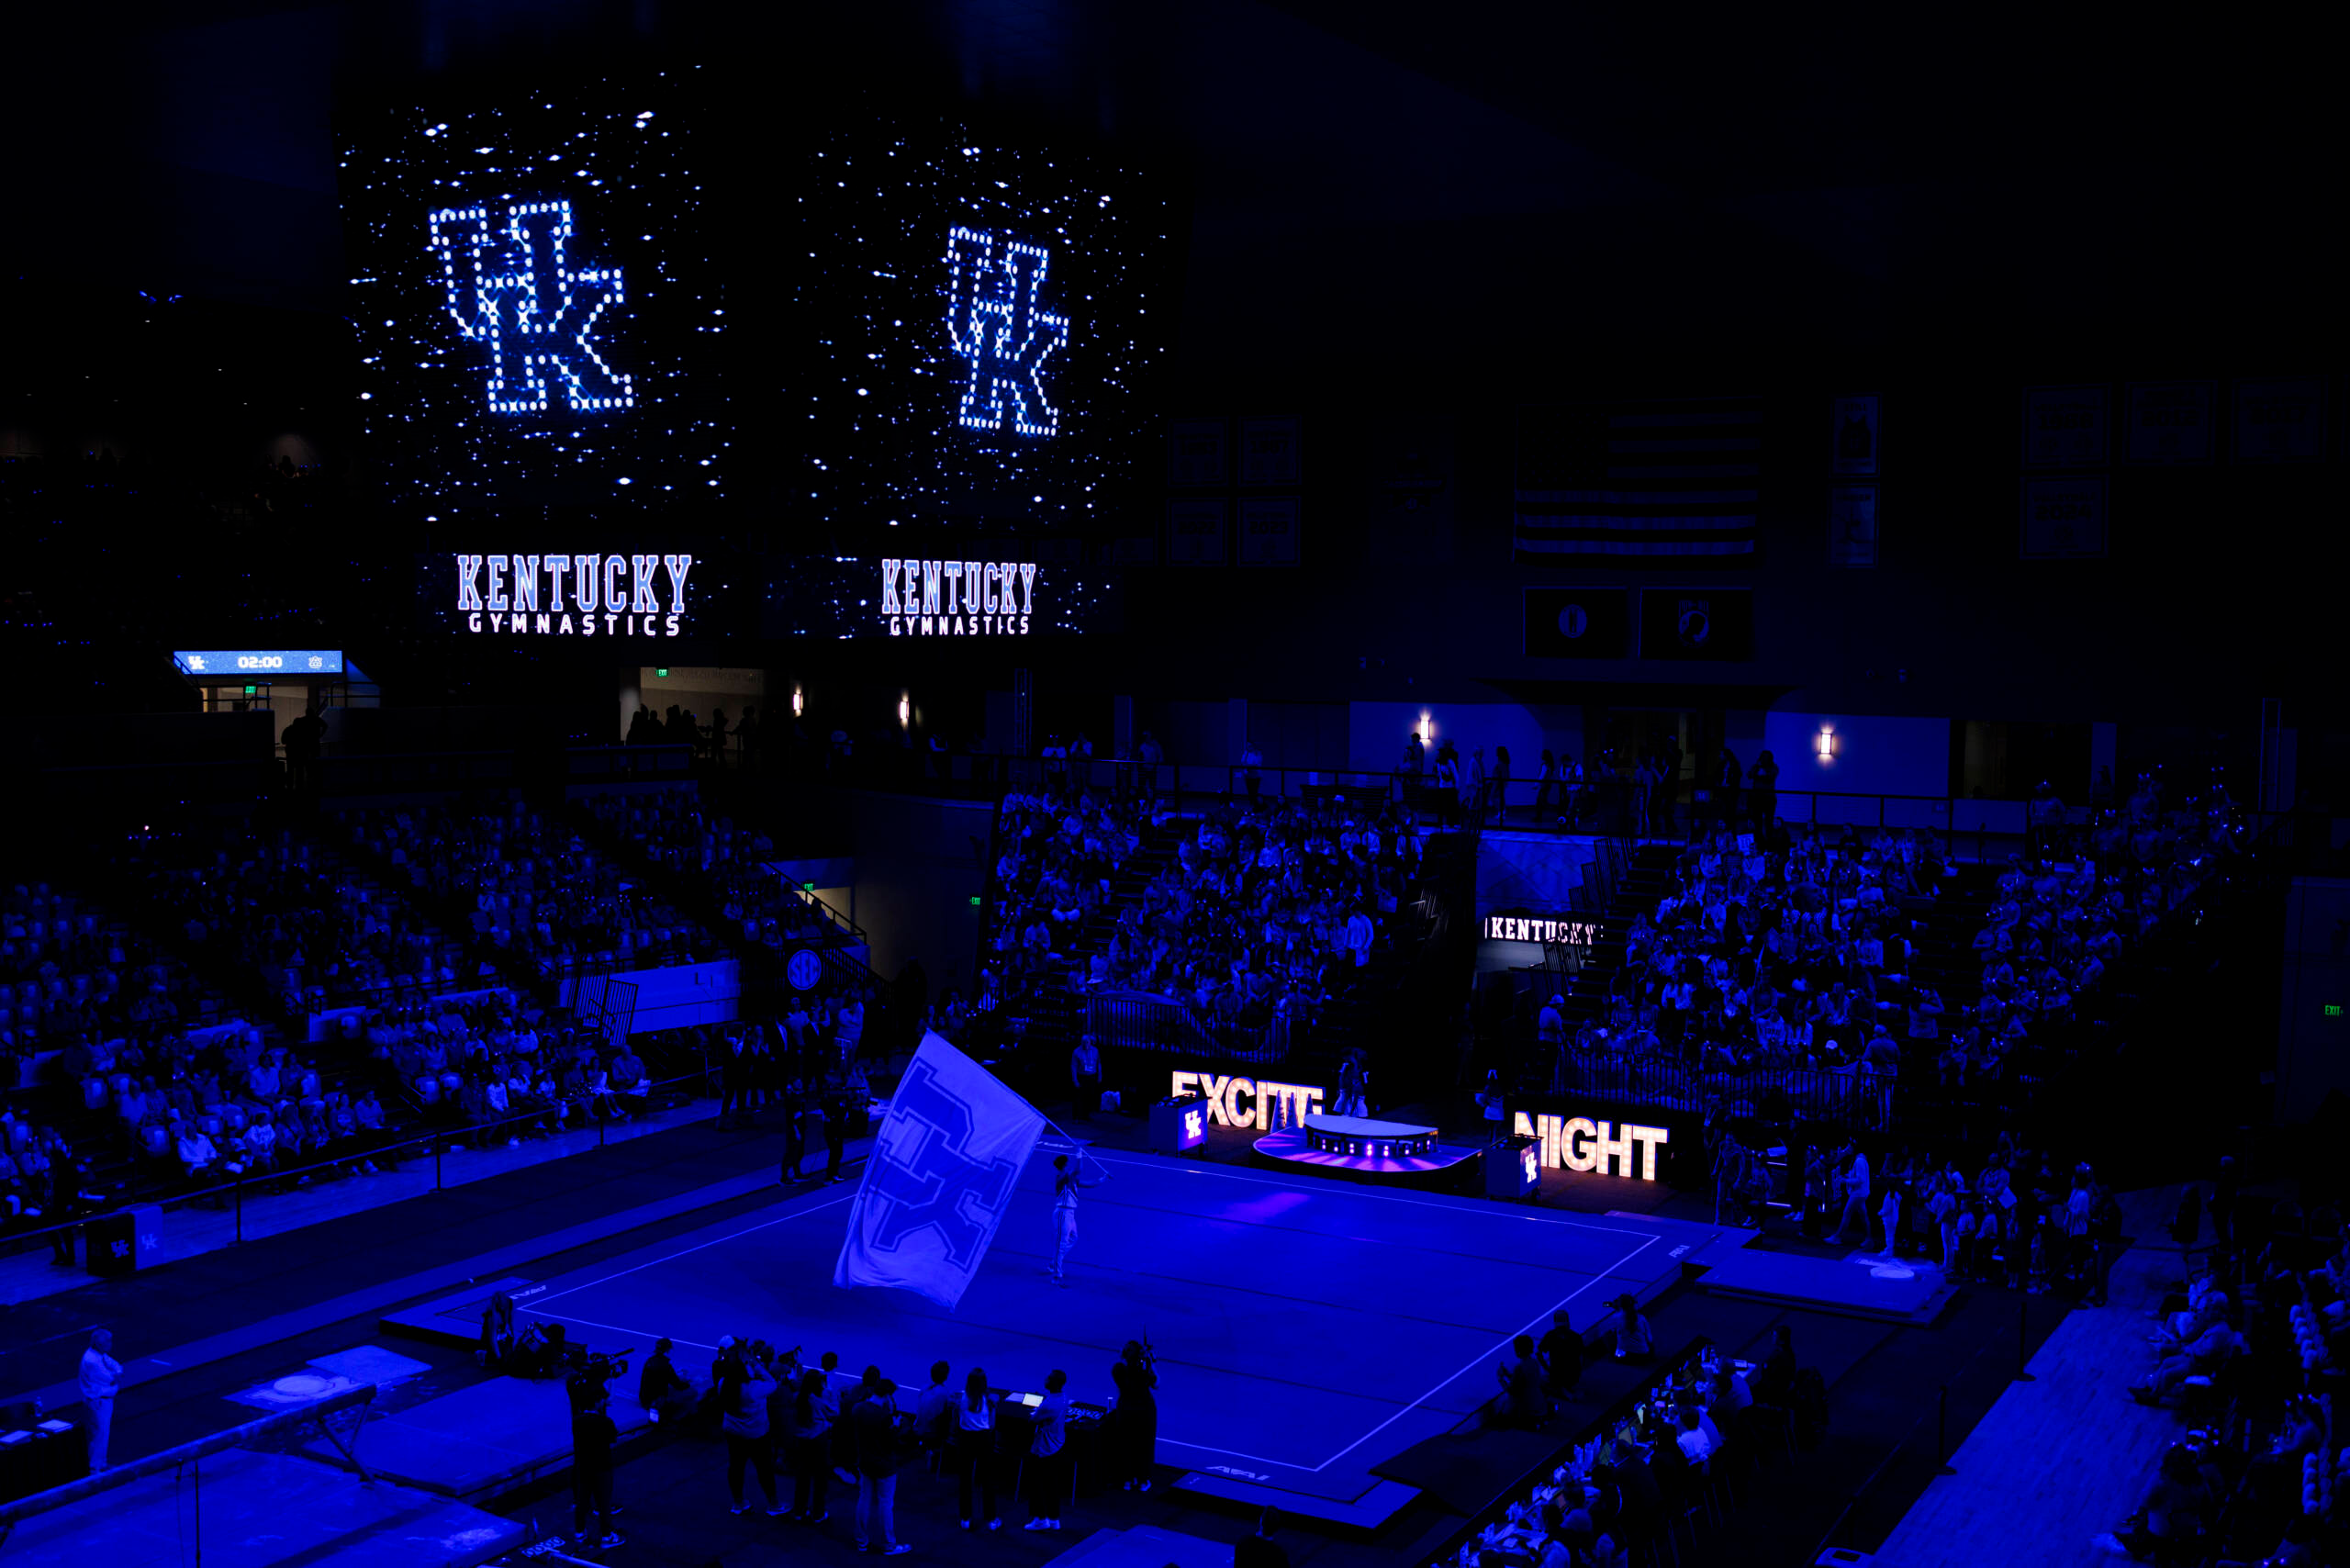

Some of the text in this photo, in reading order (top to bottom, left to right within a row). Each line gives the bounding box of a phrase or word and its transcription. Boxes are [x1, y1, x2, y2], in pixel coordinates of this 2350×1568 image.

[458, 555, 691, 612] KENTUCKY
[882, 559, 1036, 614] KENTUCKY
[469, 613, 679, 636] GYMNASTICS
[890, 617, 1029, 635] GYMNASTICS
[237, 656, 283, 668] 02:00
[791, 956, 820, 981] SEC
[2324, 1004, 2341, 1016] EXIT
[1515, 1111, 1668, 1182] NIGHT
